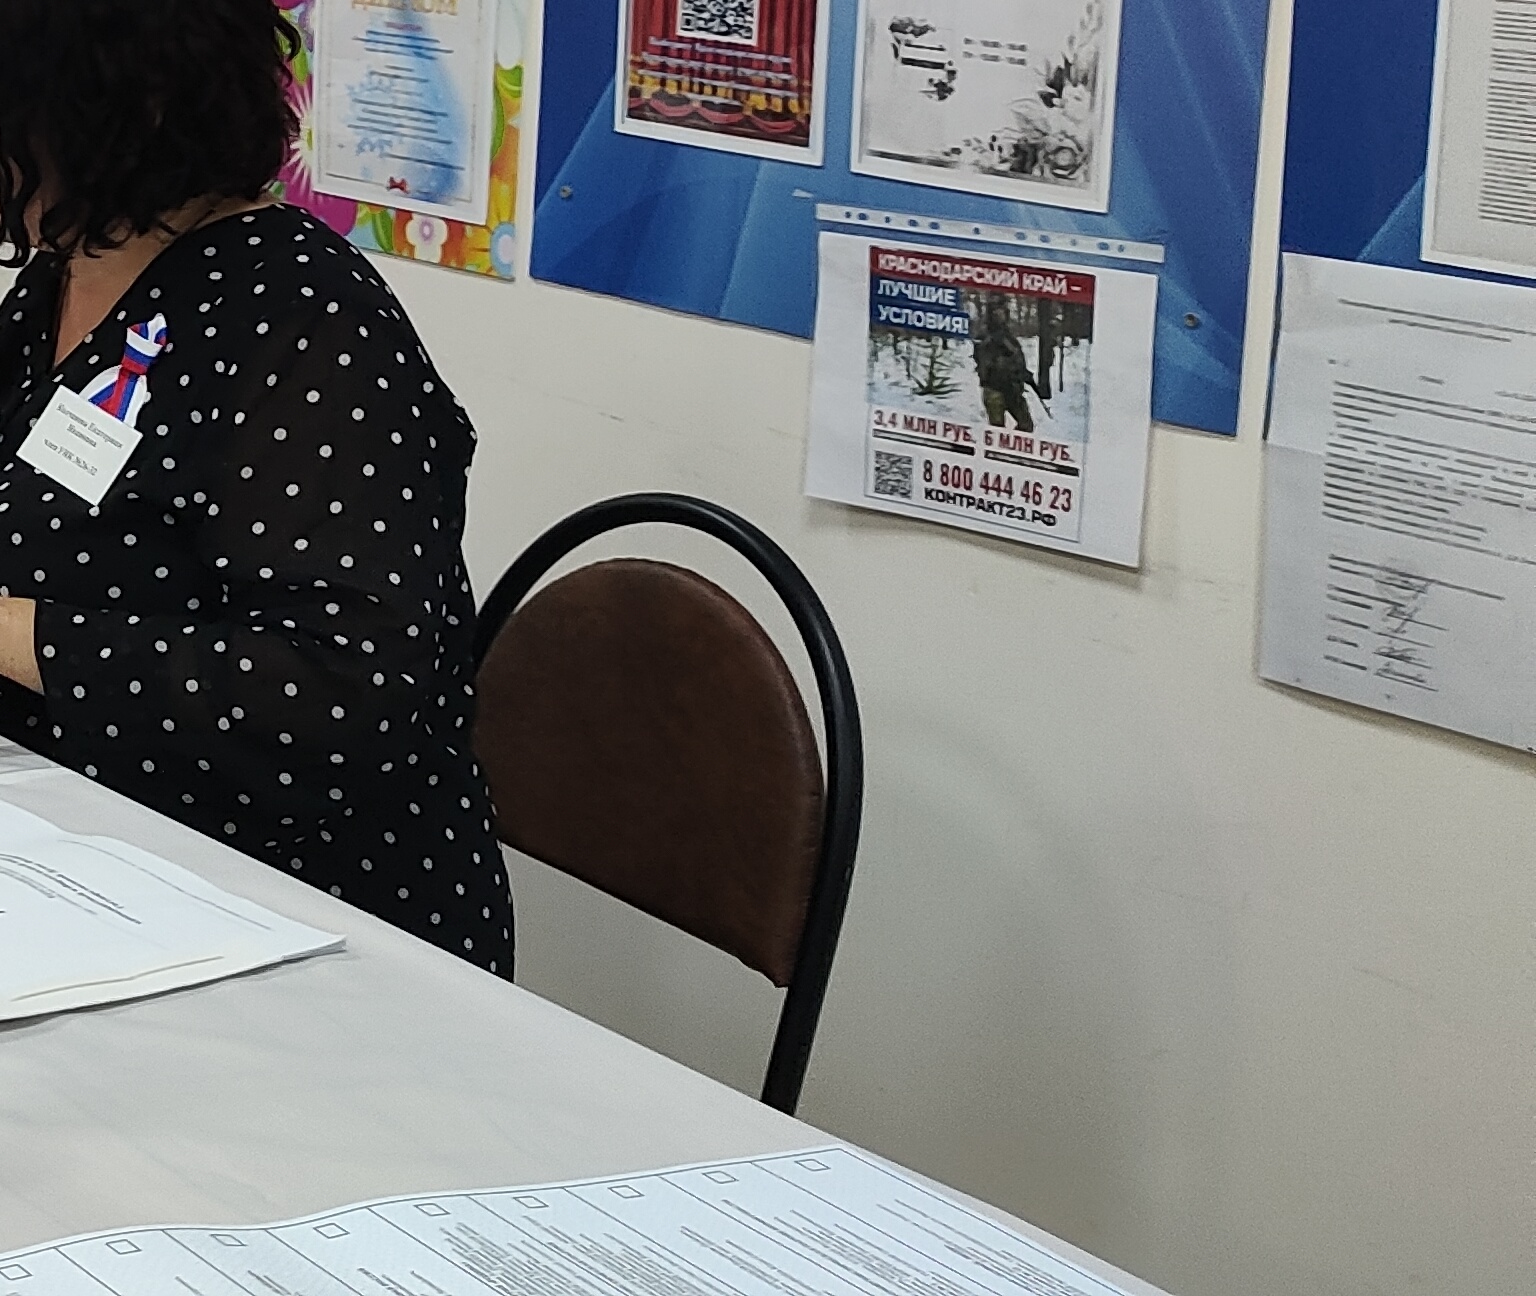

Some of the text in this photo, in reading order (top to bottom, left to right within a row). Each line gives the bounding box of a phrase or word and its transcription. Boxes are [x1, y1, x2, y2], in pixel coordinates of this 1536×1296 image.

[877, 252, 1021, 290] КРАСНОДАРСКИЙ
[1022, 272, 1068, 296] КРАЙ
[877, 279, 958, 308] ЛУЧШИЕ
[878, 303, 970, 336] УСЛОВИЯ!
[903, 414, 937, 436] МЛН
[942, 421, 977, 445] РУБ.
[984, 430, 1075, 463] 6 МЛН РУБ.
[922, 459, 1073, 513] 8 800 444 46 23
[923, 486, 1058, 527] КОНТРАКТ23.РФ
